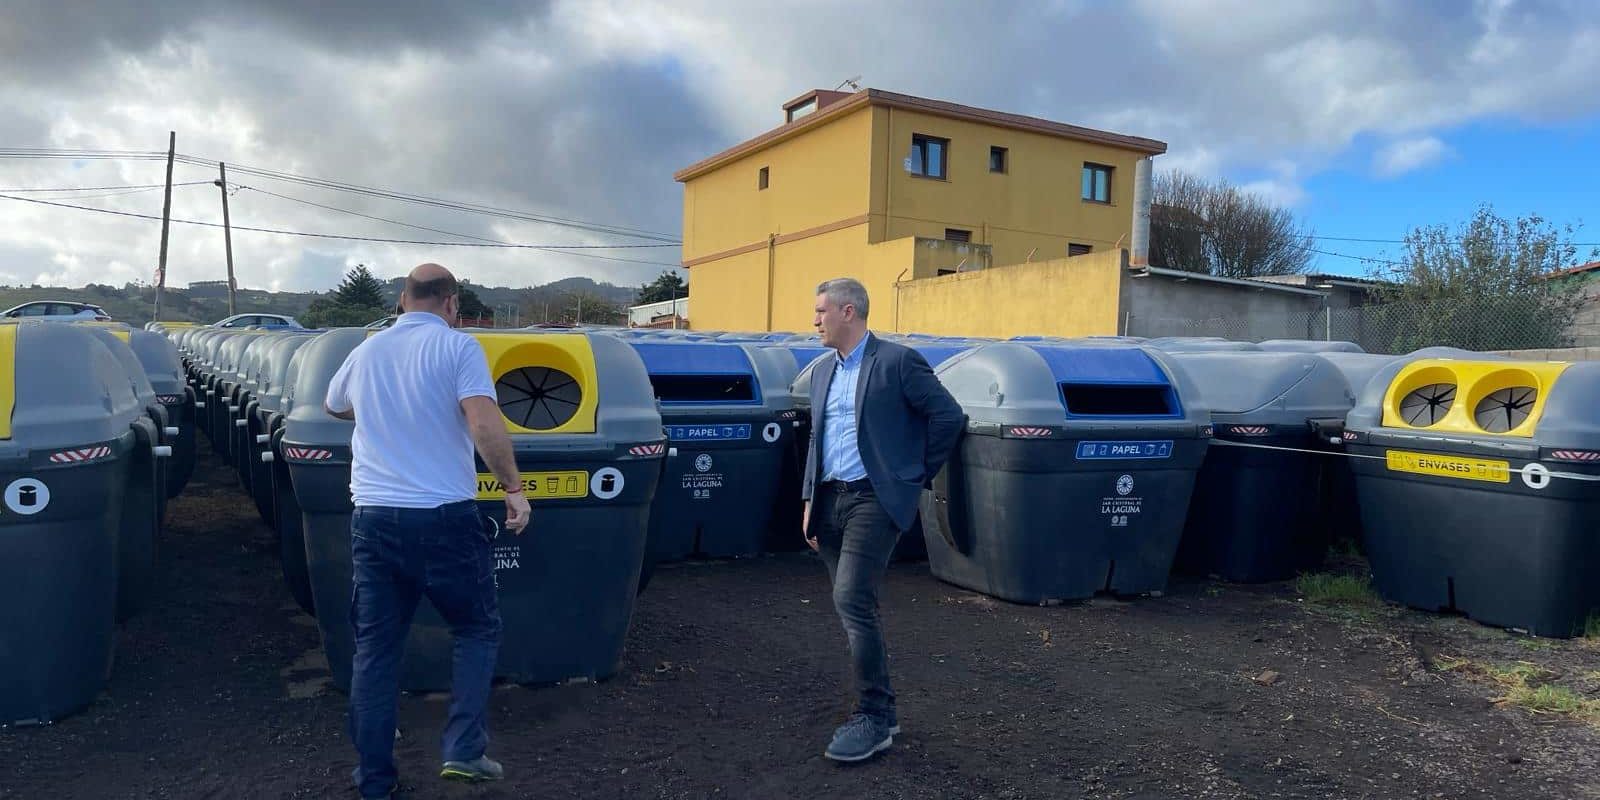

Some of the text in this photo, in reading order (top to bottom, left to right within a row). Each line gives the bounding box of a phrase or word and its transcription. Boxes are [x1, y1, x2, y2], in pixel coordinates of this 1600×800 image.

[689, 428, 718, 436] PAPEL
[1112, 446, 1140, 454] PAPEL
[1418, 459, 1470, 472] ENVASES
